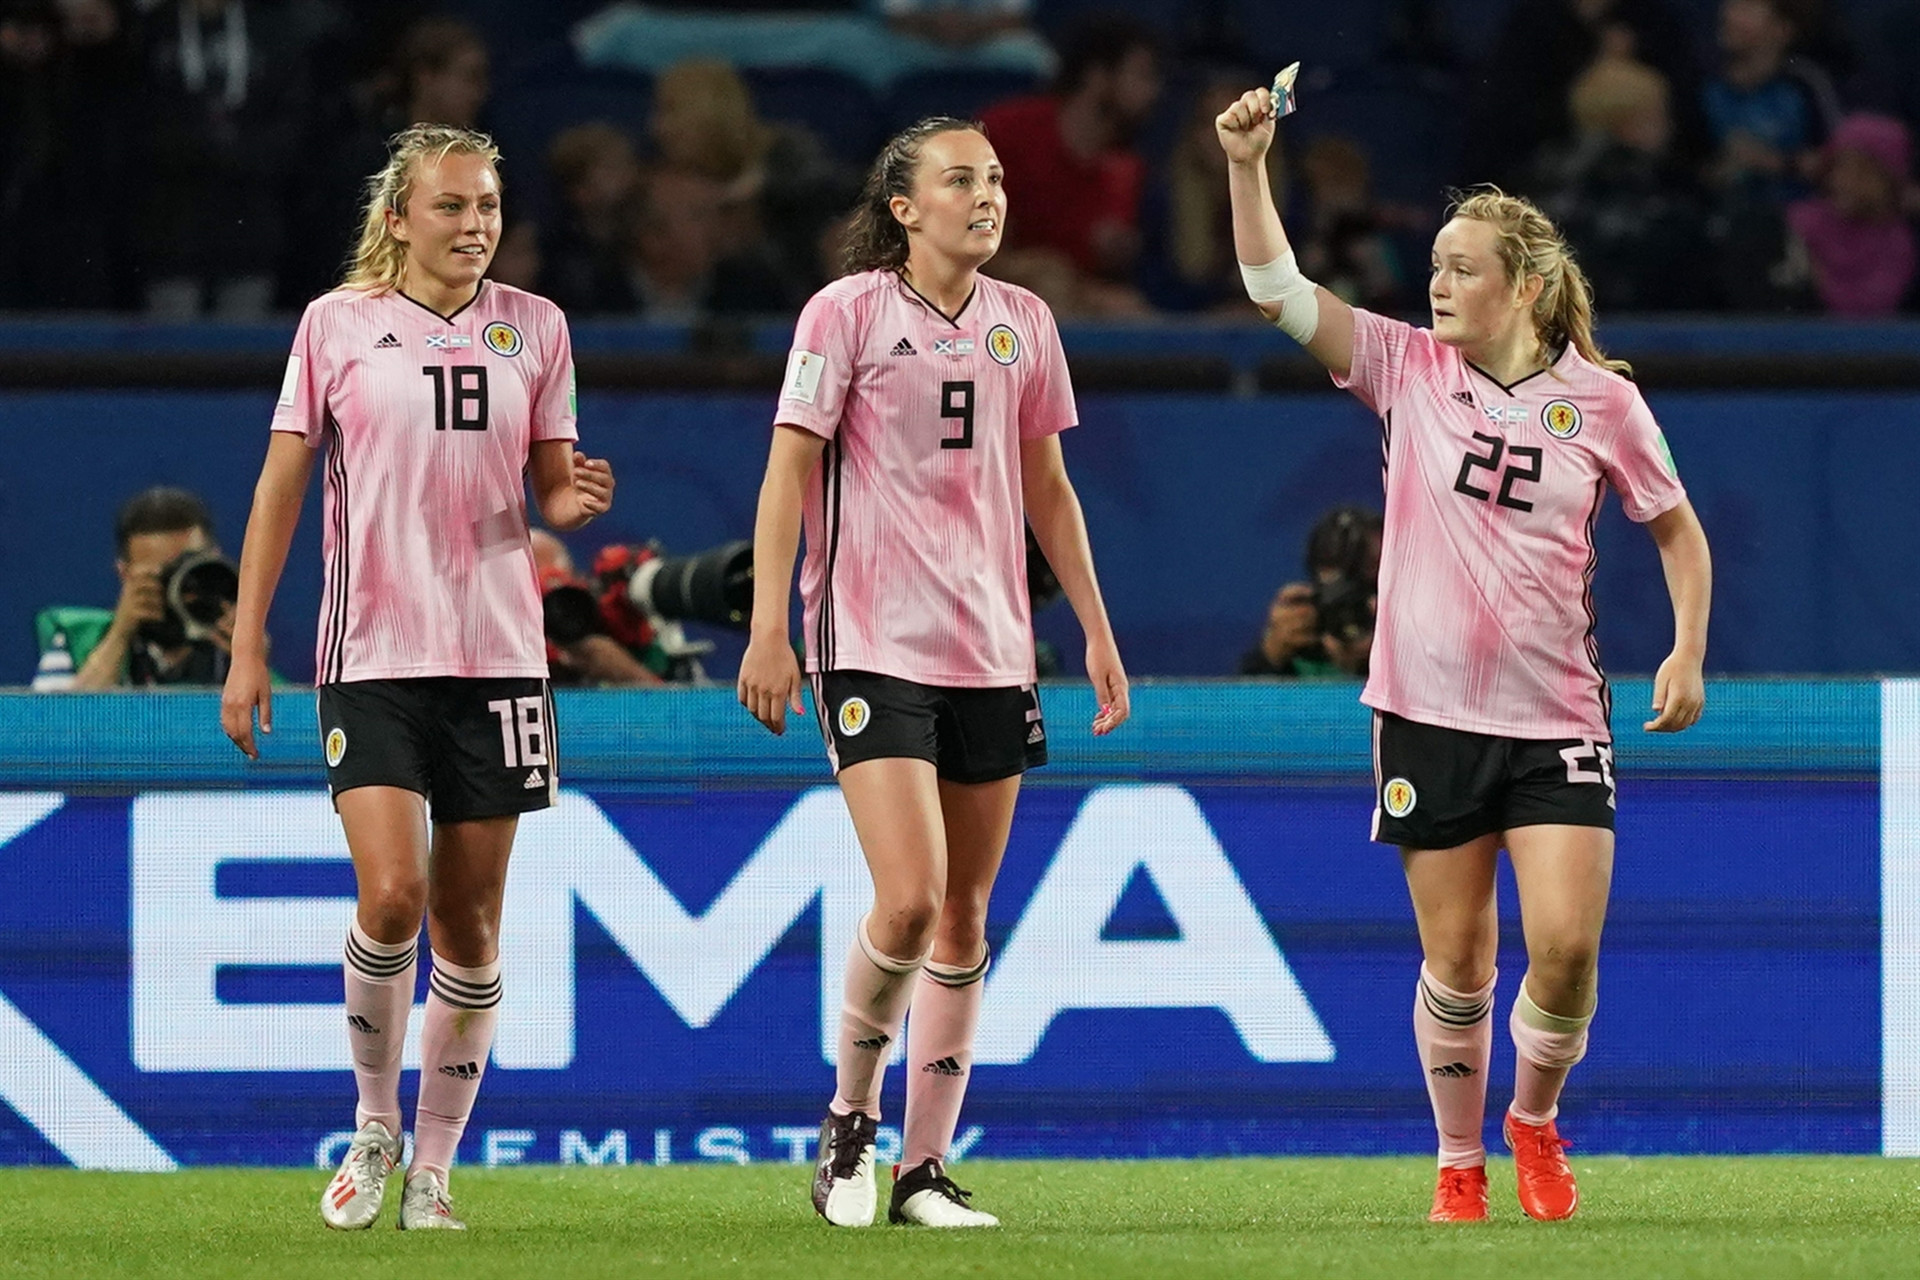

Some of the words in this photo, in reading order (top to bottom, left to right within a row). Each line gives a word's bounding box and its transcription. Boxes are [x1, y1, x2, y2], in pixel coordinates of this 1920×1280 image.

[422, 365, 489, 432] 18
[940, 380, 975, 449] 9
[1454, 430, 1543, 513] 22
[488, 696, 548, 767] 18
[922, 1065, 965, 1077] adidas
